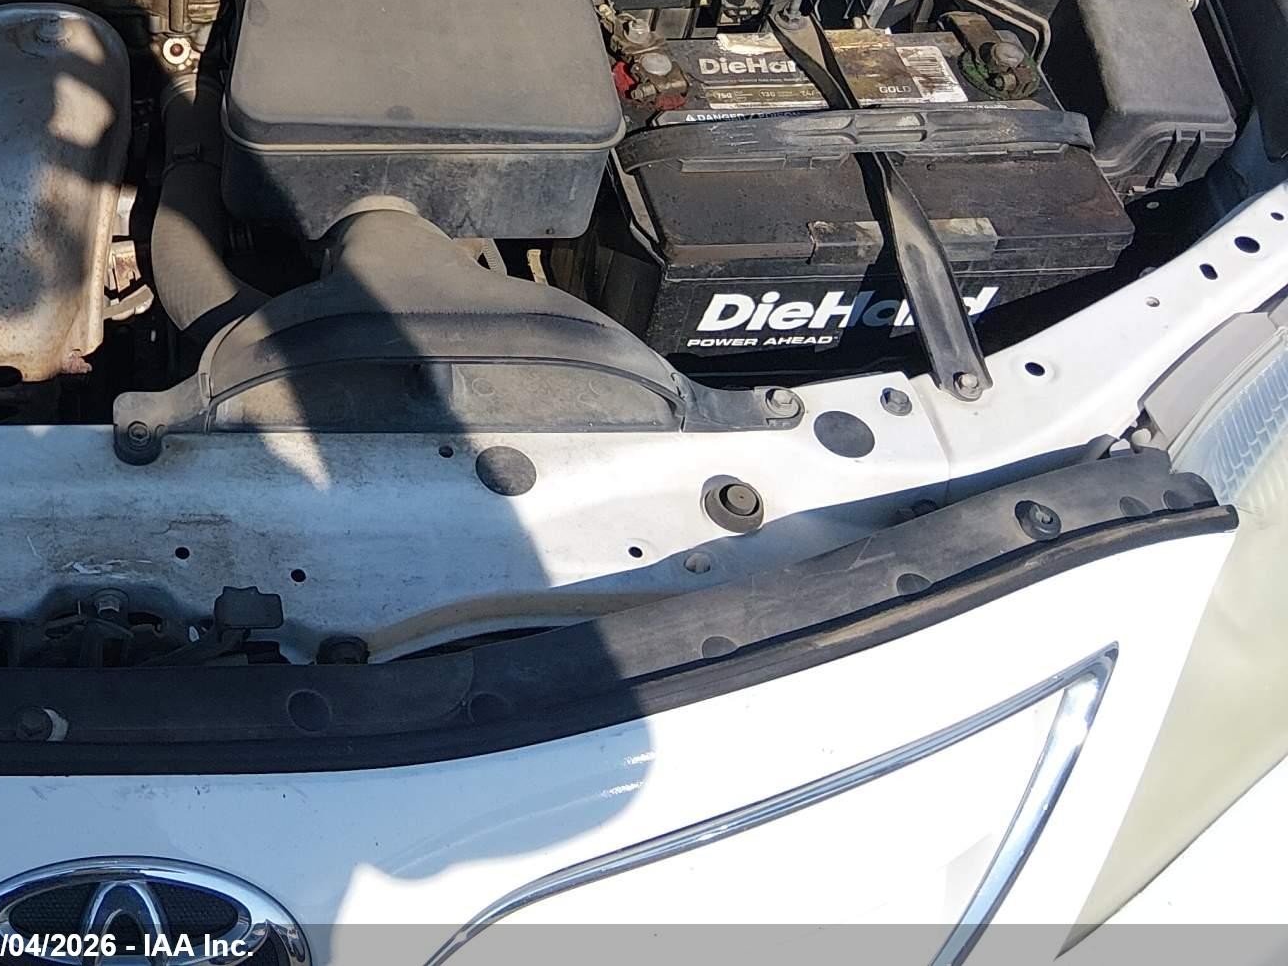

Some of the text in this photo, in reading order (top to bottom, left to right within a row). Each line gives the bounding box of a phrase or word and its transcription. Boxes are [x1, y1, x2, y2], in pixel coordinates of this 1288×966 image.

[878, 84, 912, 94] GOLD
[686, 335, 833, 348] POWER AHEAD
